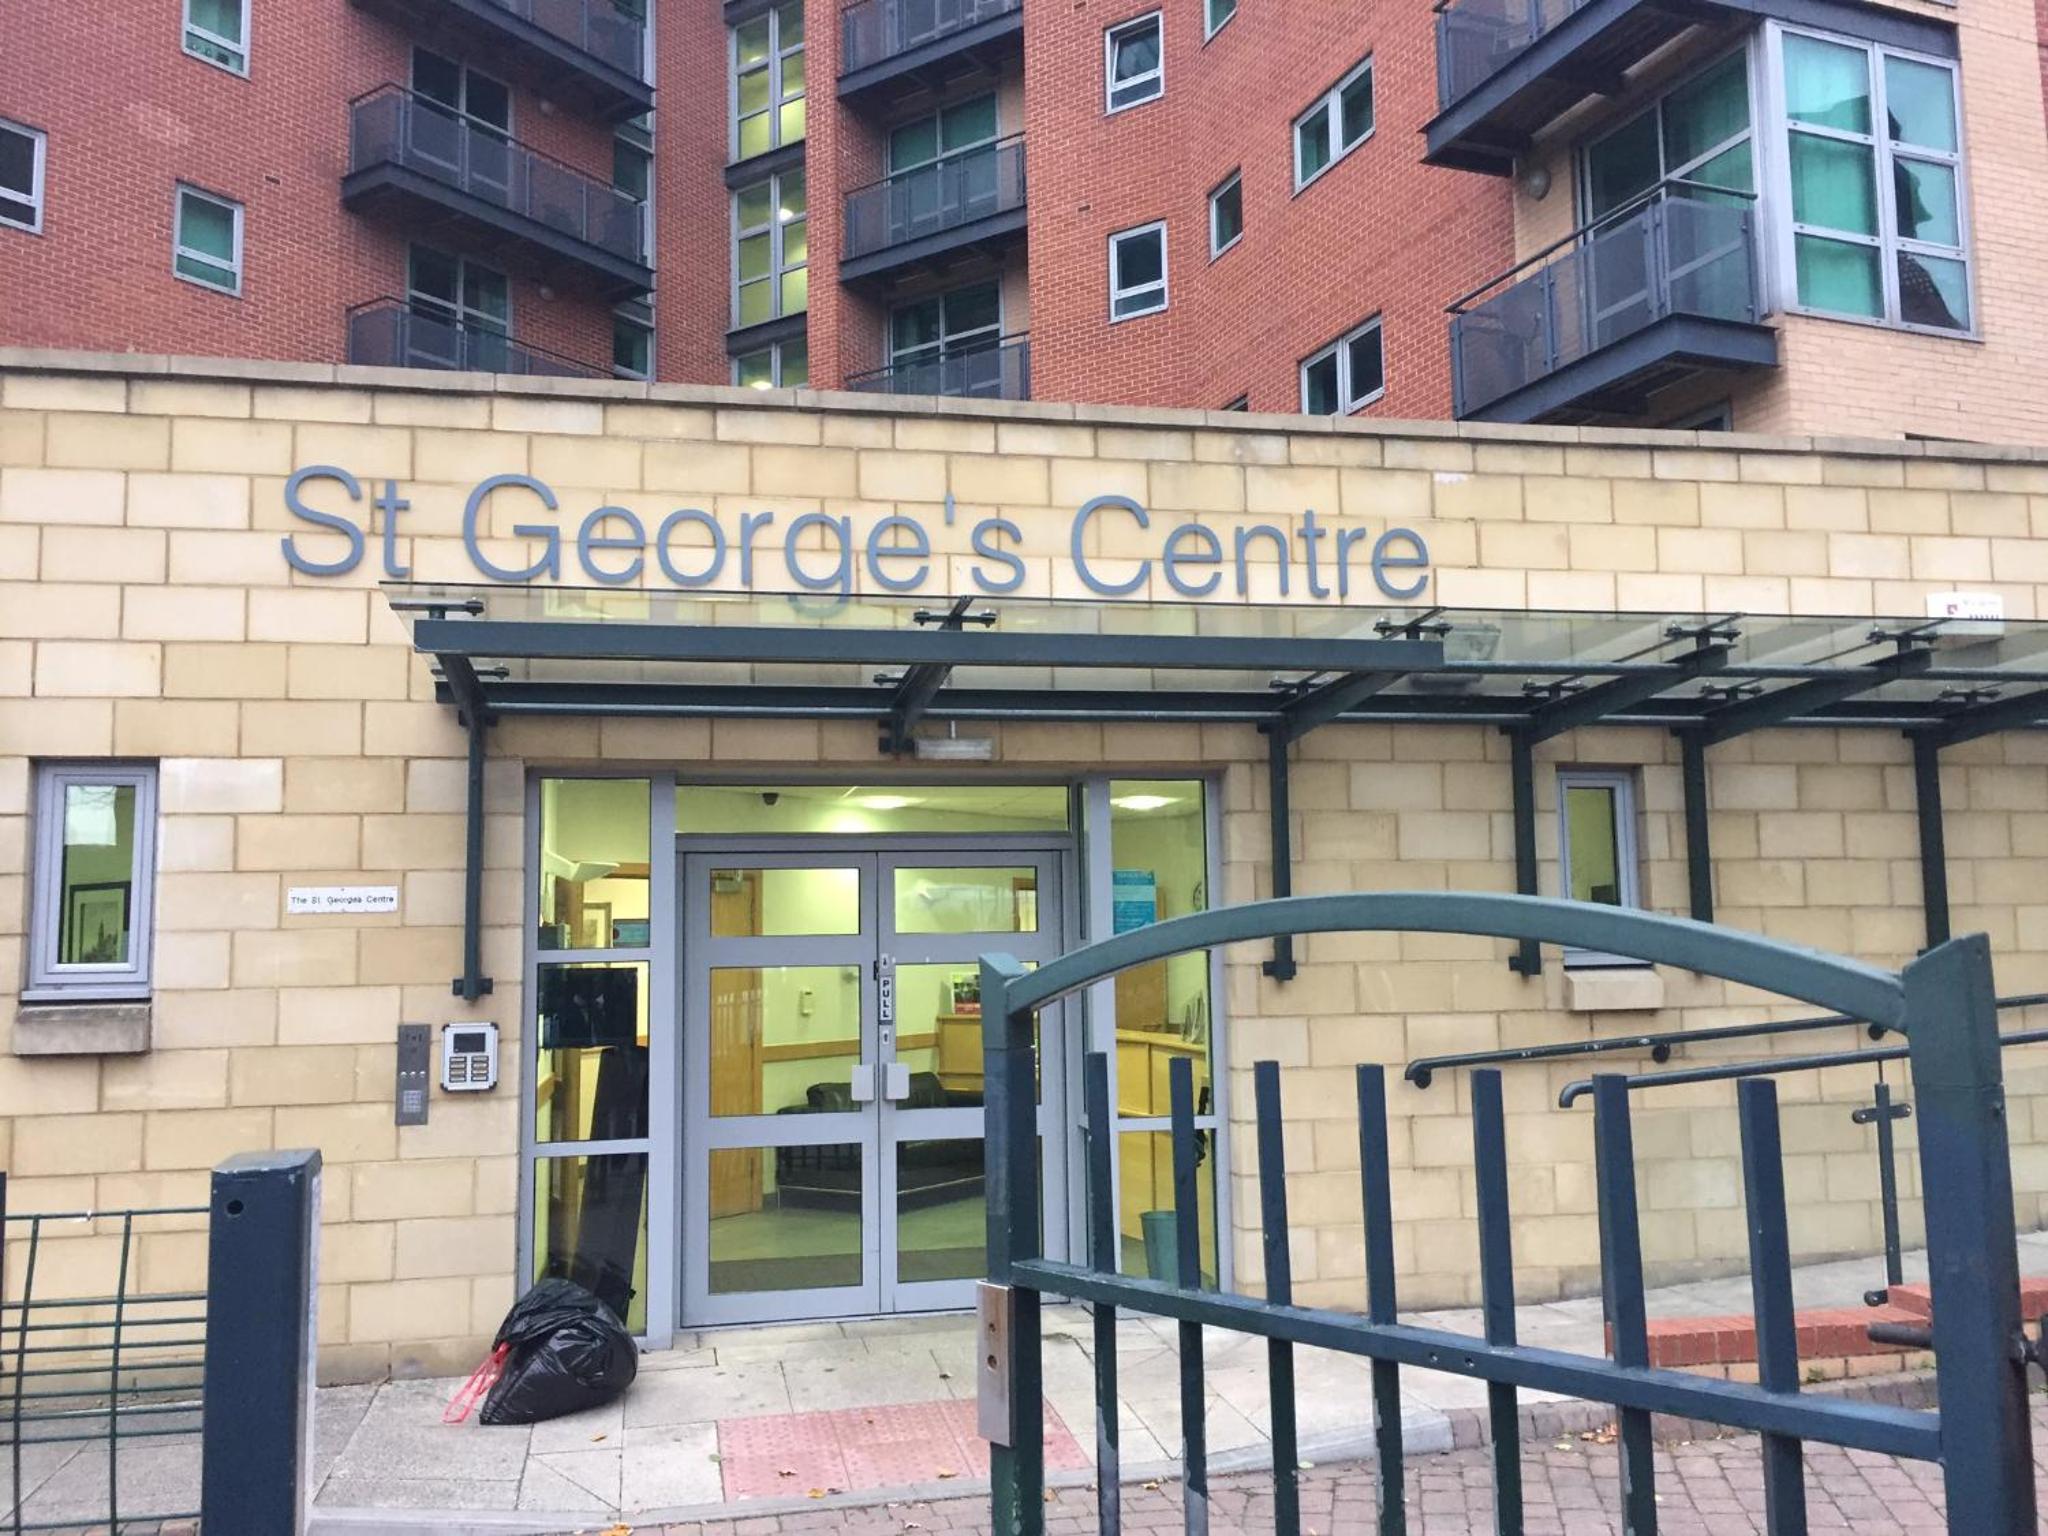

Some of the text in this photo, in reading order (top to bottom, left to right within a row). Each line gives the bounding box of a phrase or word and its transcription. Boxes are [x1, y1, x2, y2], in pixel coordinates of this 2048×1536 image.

[280, 465, 1430, 618] St George's Centre
[366, 894, 394, 904] Centre
[882, 979, 891, 1019] PULL
